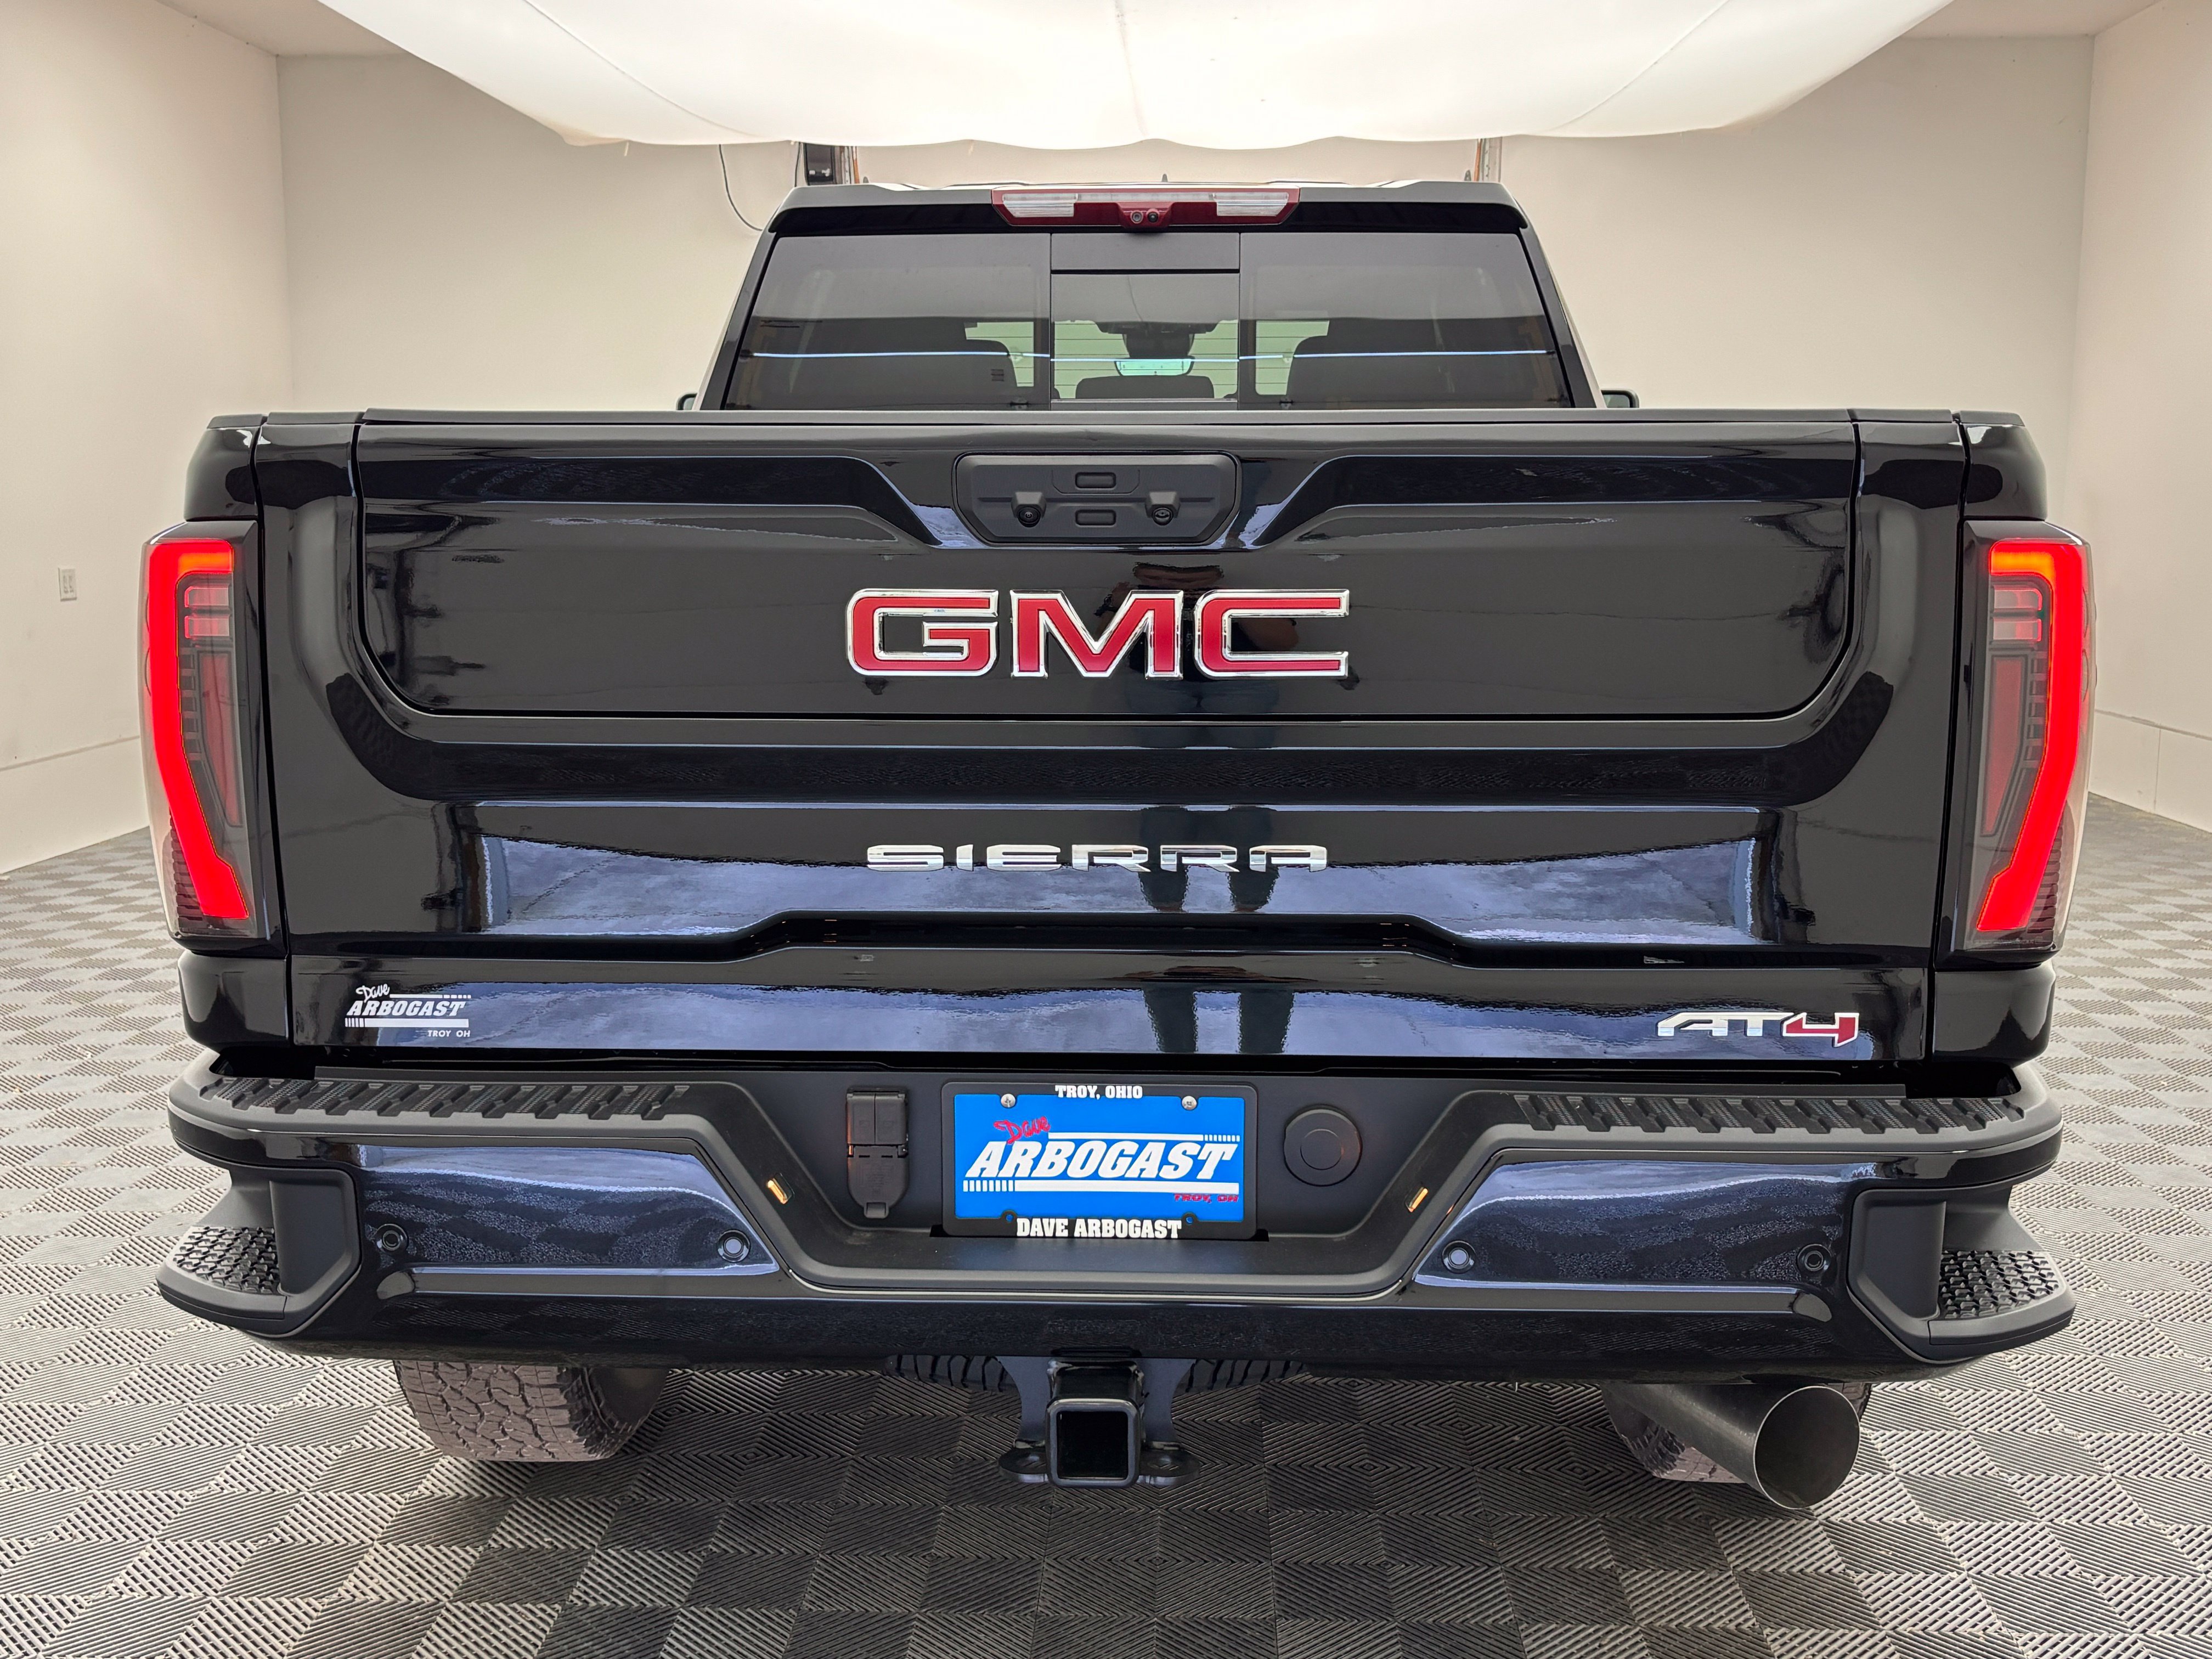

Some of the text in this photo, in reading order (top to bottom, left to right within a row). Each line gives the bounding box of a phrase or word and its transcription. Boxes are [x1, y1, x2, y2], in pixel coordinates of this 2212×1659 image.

[847, 589, 1350, 679] GMC
[867, 844, 1327, 872] SIERRA
[356, 984, 390, 1002] Dave
[346, 1001, 466, 1016] ARBOGAST
[1657, 1012, 1859, 1047] AT4
[1055, 1085, 1143, 1099] TROY, OHIO
[994, 1116, 1051, 1145] Dave
[965, 1141, 1238, 1180] ARBOGAST
[1217, 1194, 1239, 1203] OH
[1017, 1218, 1182, 1239] DAVE ARBOGAST
